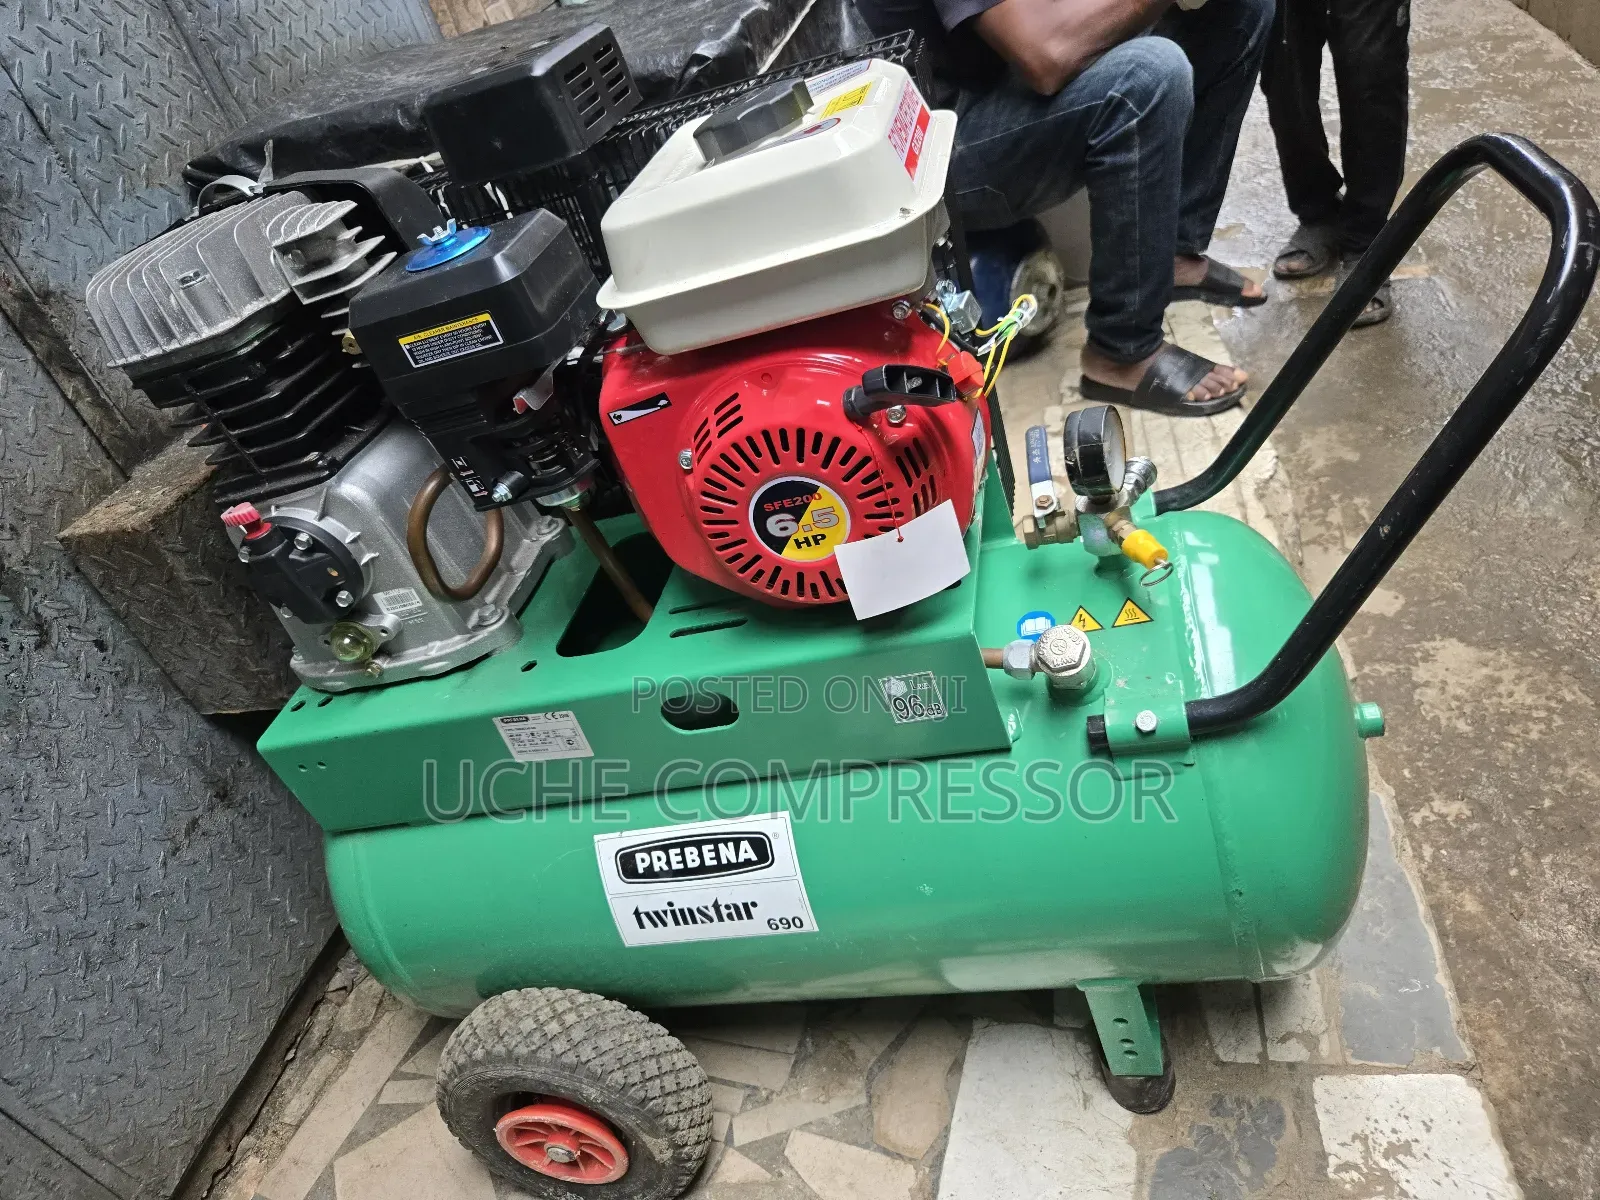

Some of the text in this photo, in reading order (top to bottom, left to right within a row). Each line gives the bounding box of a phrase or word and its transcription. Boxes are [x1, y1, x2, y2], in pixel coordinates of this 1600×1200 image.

[764, 492, 822, 512] SFE200
[766, 506, 840, 538] 6.5
[793, 533, 827, 550] HP
[634, 839, 758, 874] PREBENA
[632, 897, 804, 931] twinstar 690
